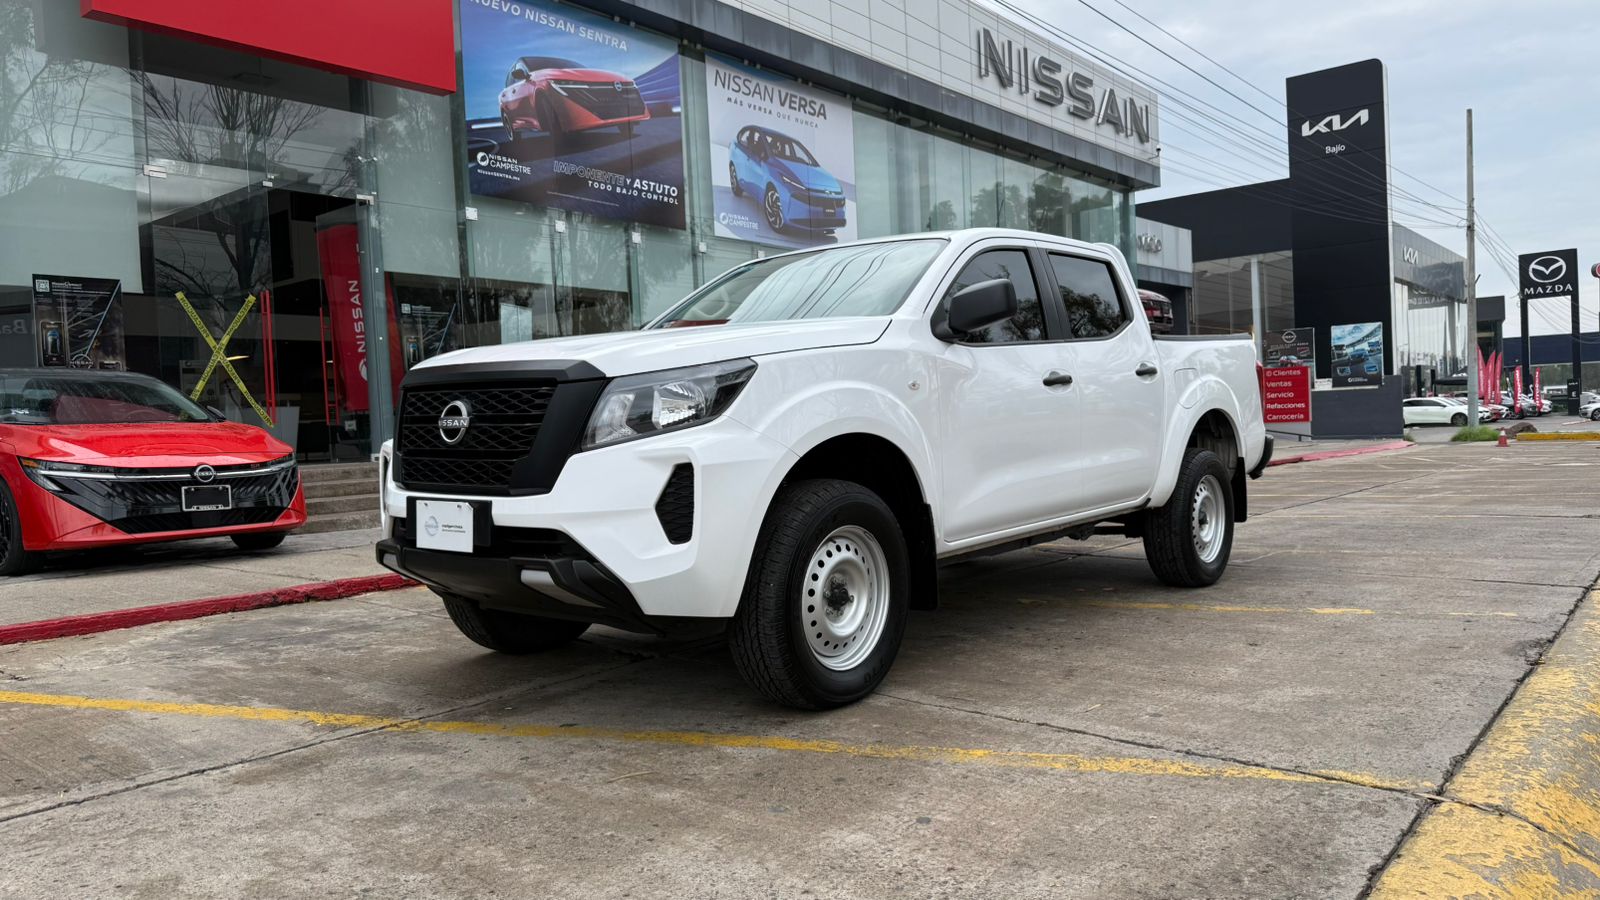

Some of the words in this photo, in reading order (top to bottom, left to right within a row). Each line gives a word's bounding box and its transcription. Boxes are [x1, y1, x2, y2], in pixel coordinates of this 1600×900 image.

[525, 8, 575, 34] NISSAN
[578, 26, 628, 52] SENTRA
[714, 69, 774, 104] NISSAN
[778, 89, 828, 121] VERSA
[977, 27, 1150, 144] NISSAN
[727, 96, 743, 107] MÁS
[747, 103, 772, 115] VERSA
[776, 112, 791, 121] QUE
[794, 117, 819, 129] NUNCA
[488, 153, 518, 165] NISSAN
[1325, 143, 1346, 155] Bajío
[490, 160, 532, 175] CAMPESTRE
[553, 160, 625, 187] IMPONENTE
[626, 178, 632, 186] Y
[633, 178, 679, 197] ASTUTO
[588, 181, 613, 192] TODO
[616, 187, 639, 197] BAJO
[641, 191, 679, 206] CONTROL
[1524, 283, 1573, 296] MAZDA
[347, 280, 367, 353] NISSAN
[1266, 380, 1292, 388] Ventas
[1266, 391, 1295, 399] Servicio
